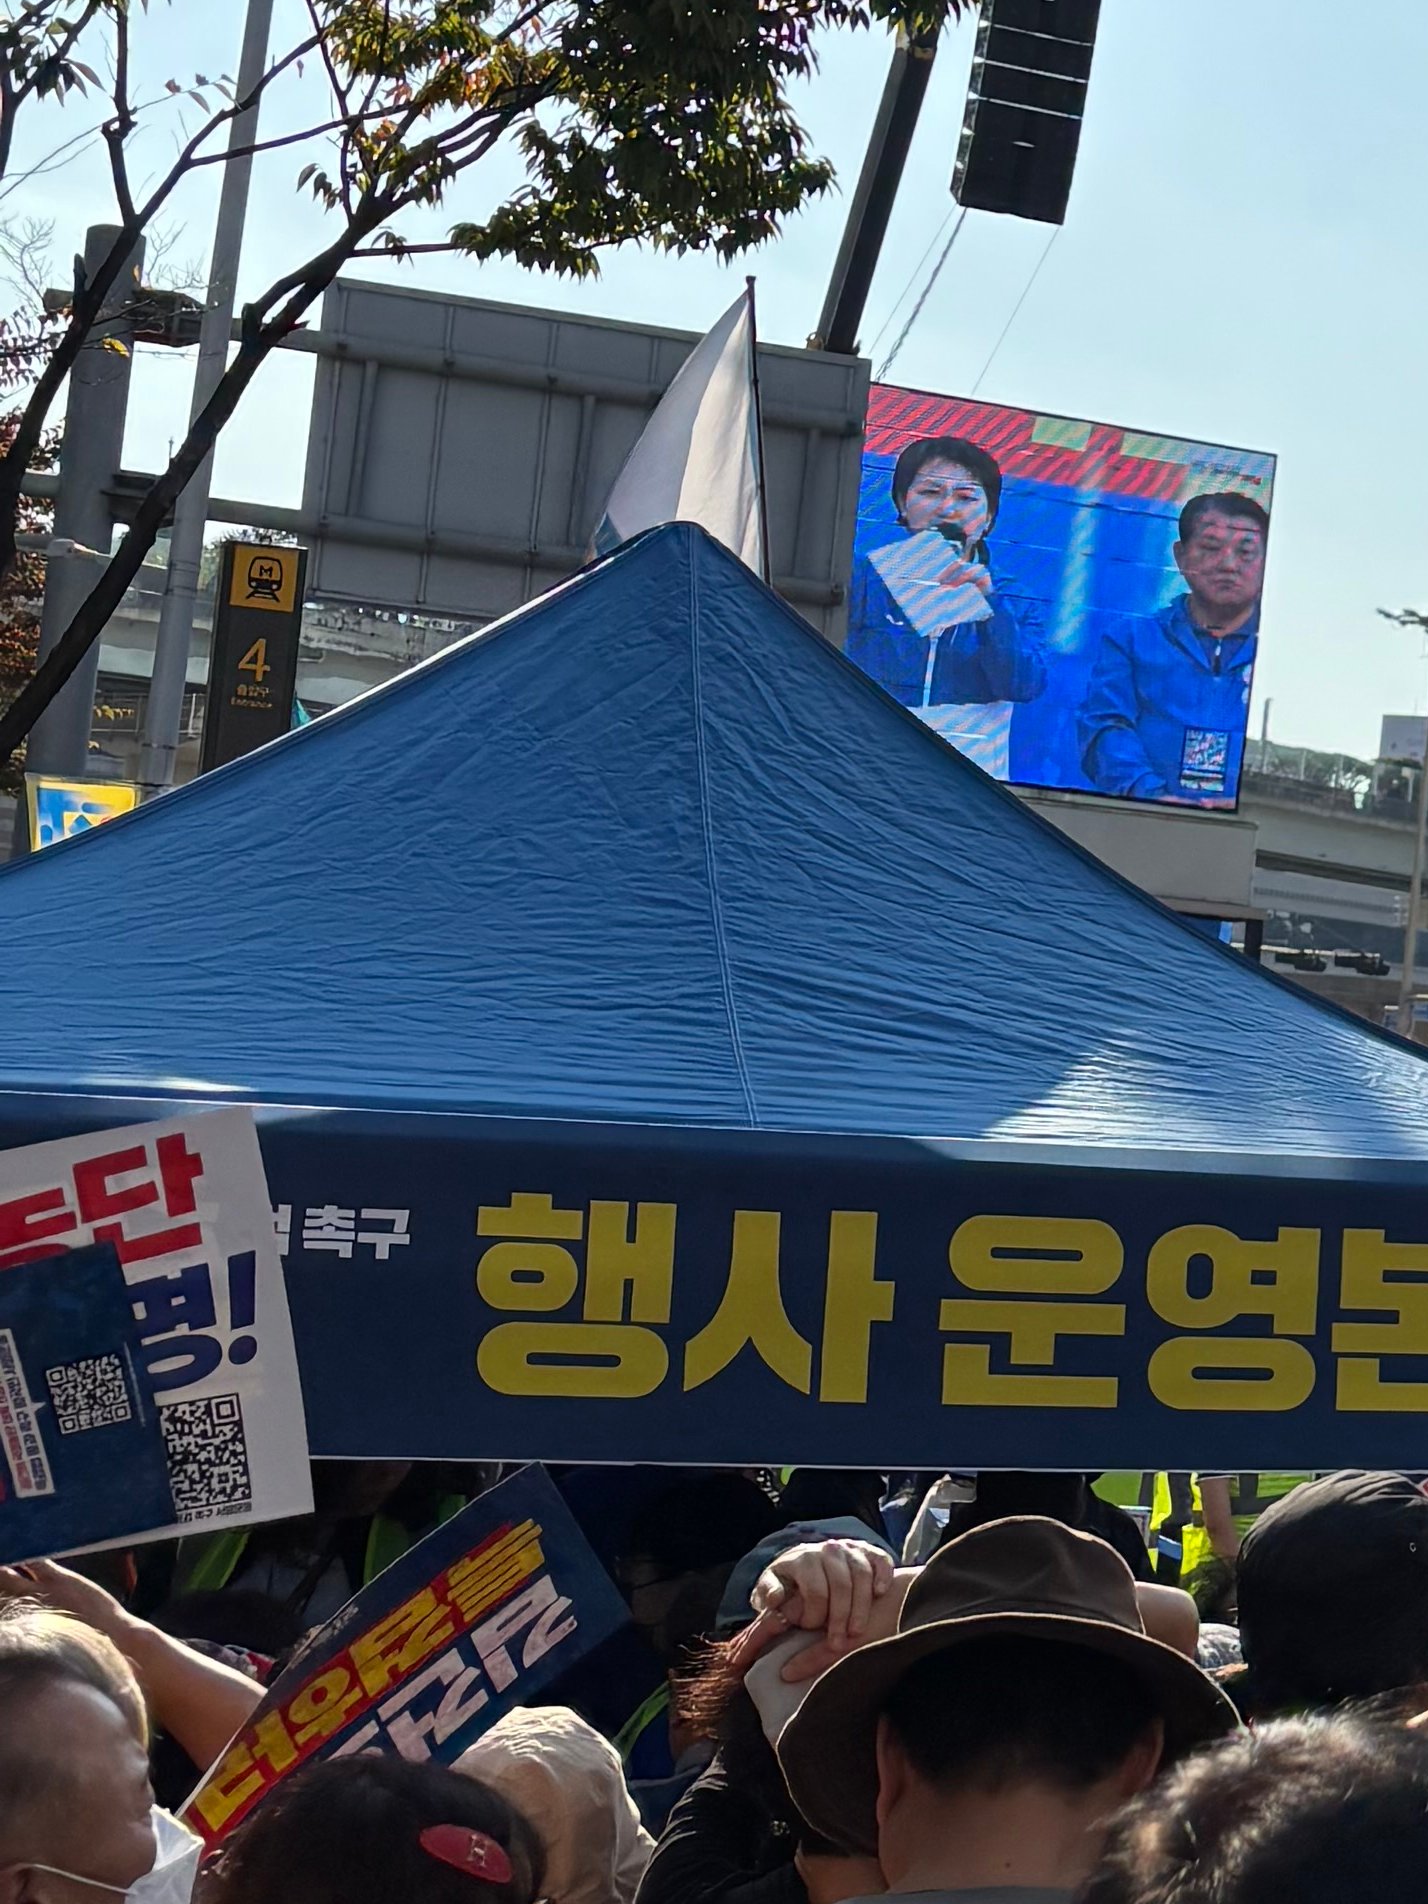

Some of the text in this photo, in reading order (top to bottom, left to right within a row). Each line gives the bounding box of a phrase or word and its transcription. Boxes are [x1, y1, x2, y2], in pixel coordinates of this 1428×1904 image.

[238, 638, 270, 682] 4
[303, 1205, 411, 1260] 촉구
[477, 1194, 893, 1402] 행사
[196, 1519, 544, 1831] 특검하
[330, 1575, 577, 1761] 김건
